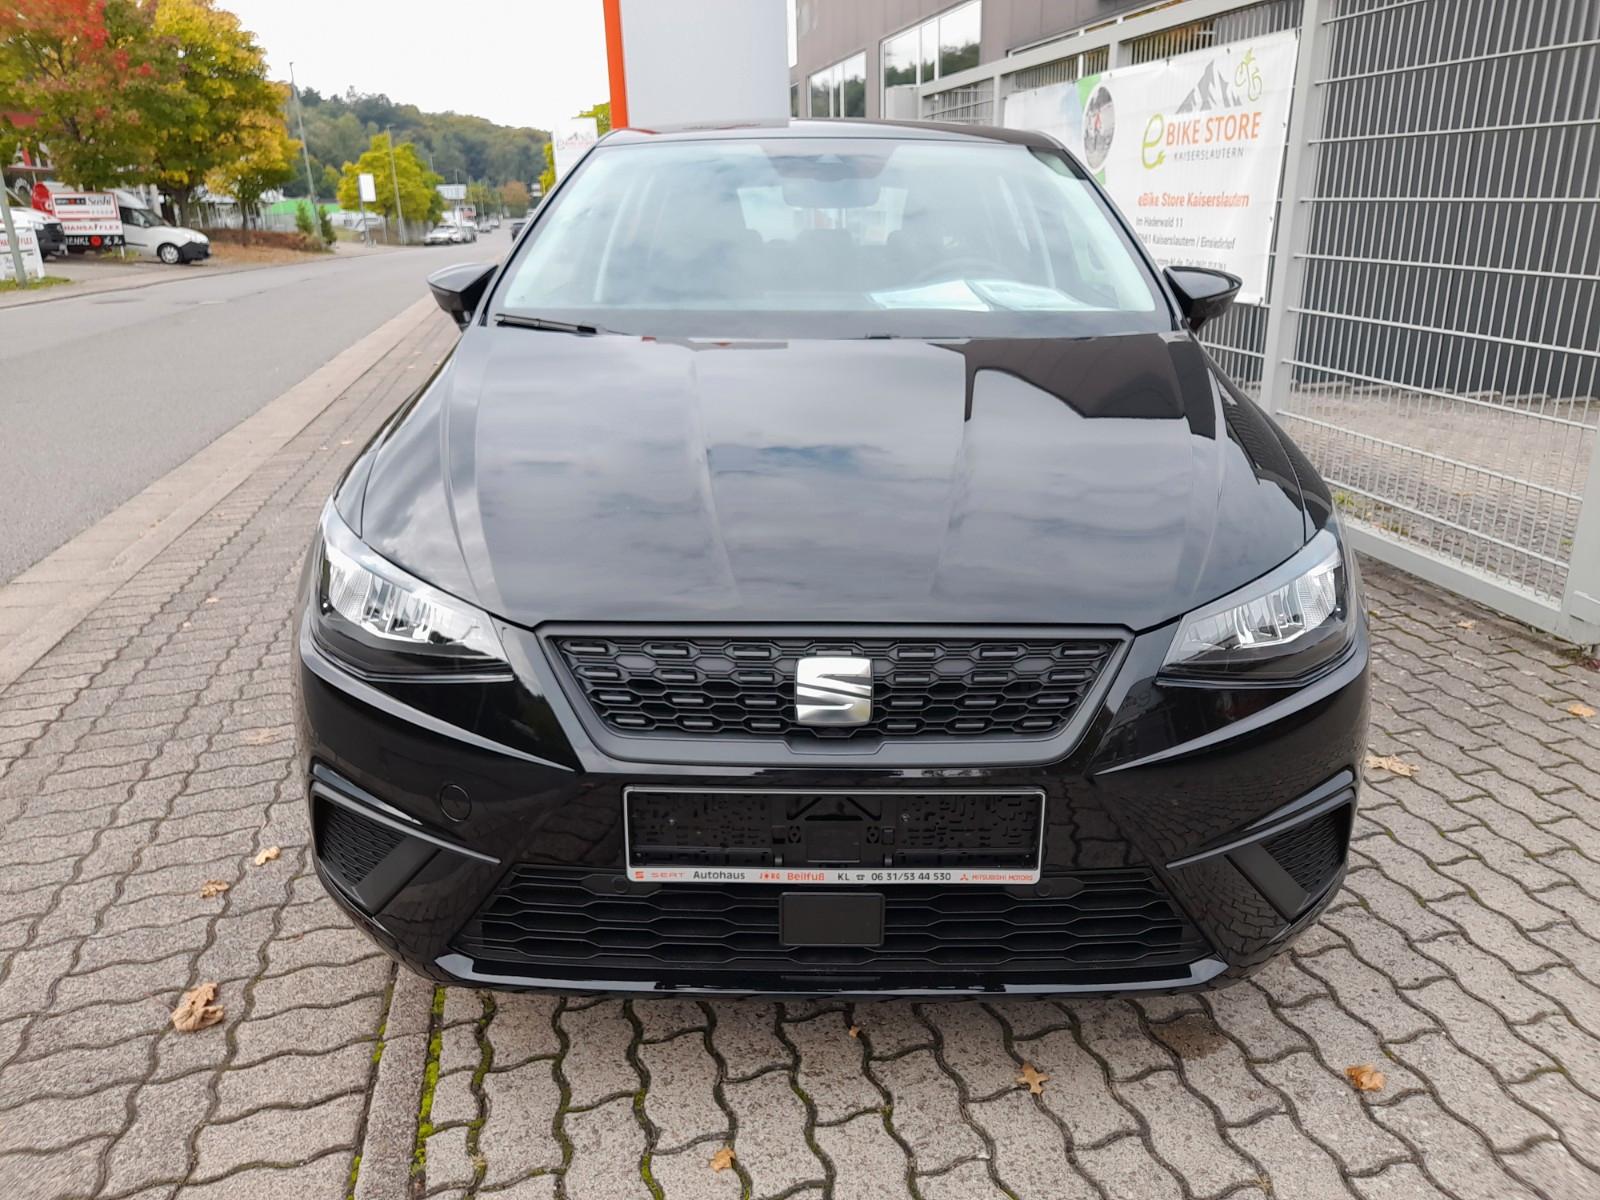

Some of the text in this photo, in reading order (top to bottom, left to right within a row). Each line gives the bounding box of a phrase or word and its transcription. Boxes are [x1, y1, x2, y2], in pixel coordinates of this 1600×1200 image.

[1166, 119, 1200, 146] BIKE
[1205, 111, 1262, 142] STORE
[1174, 147, 1244, 161] KAISERSLAUTERN
[1162, 192, 1185, 207] Store
[1187, 191, 1250, 208] Kaiserslautern
[693, 870, 745, 880] Autohaus
[838, 872, 849, 881] KL
[871, 872, 883, 881] 06
[886, 872, 915, 881] 31/53
[918, 872, 930, 881] 44
[933, 872, 951, 881] 530
